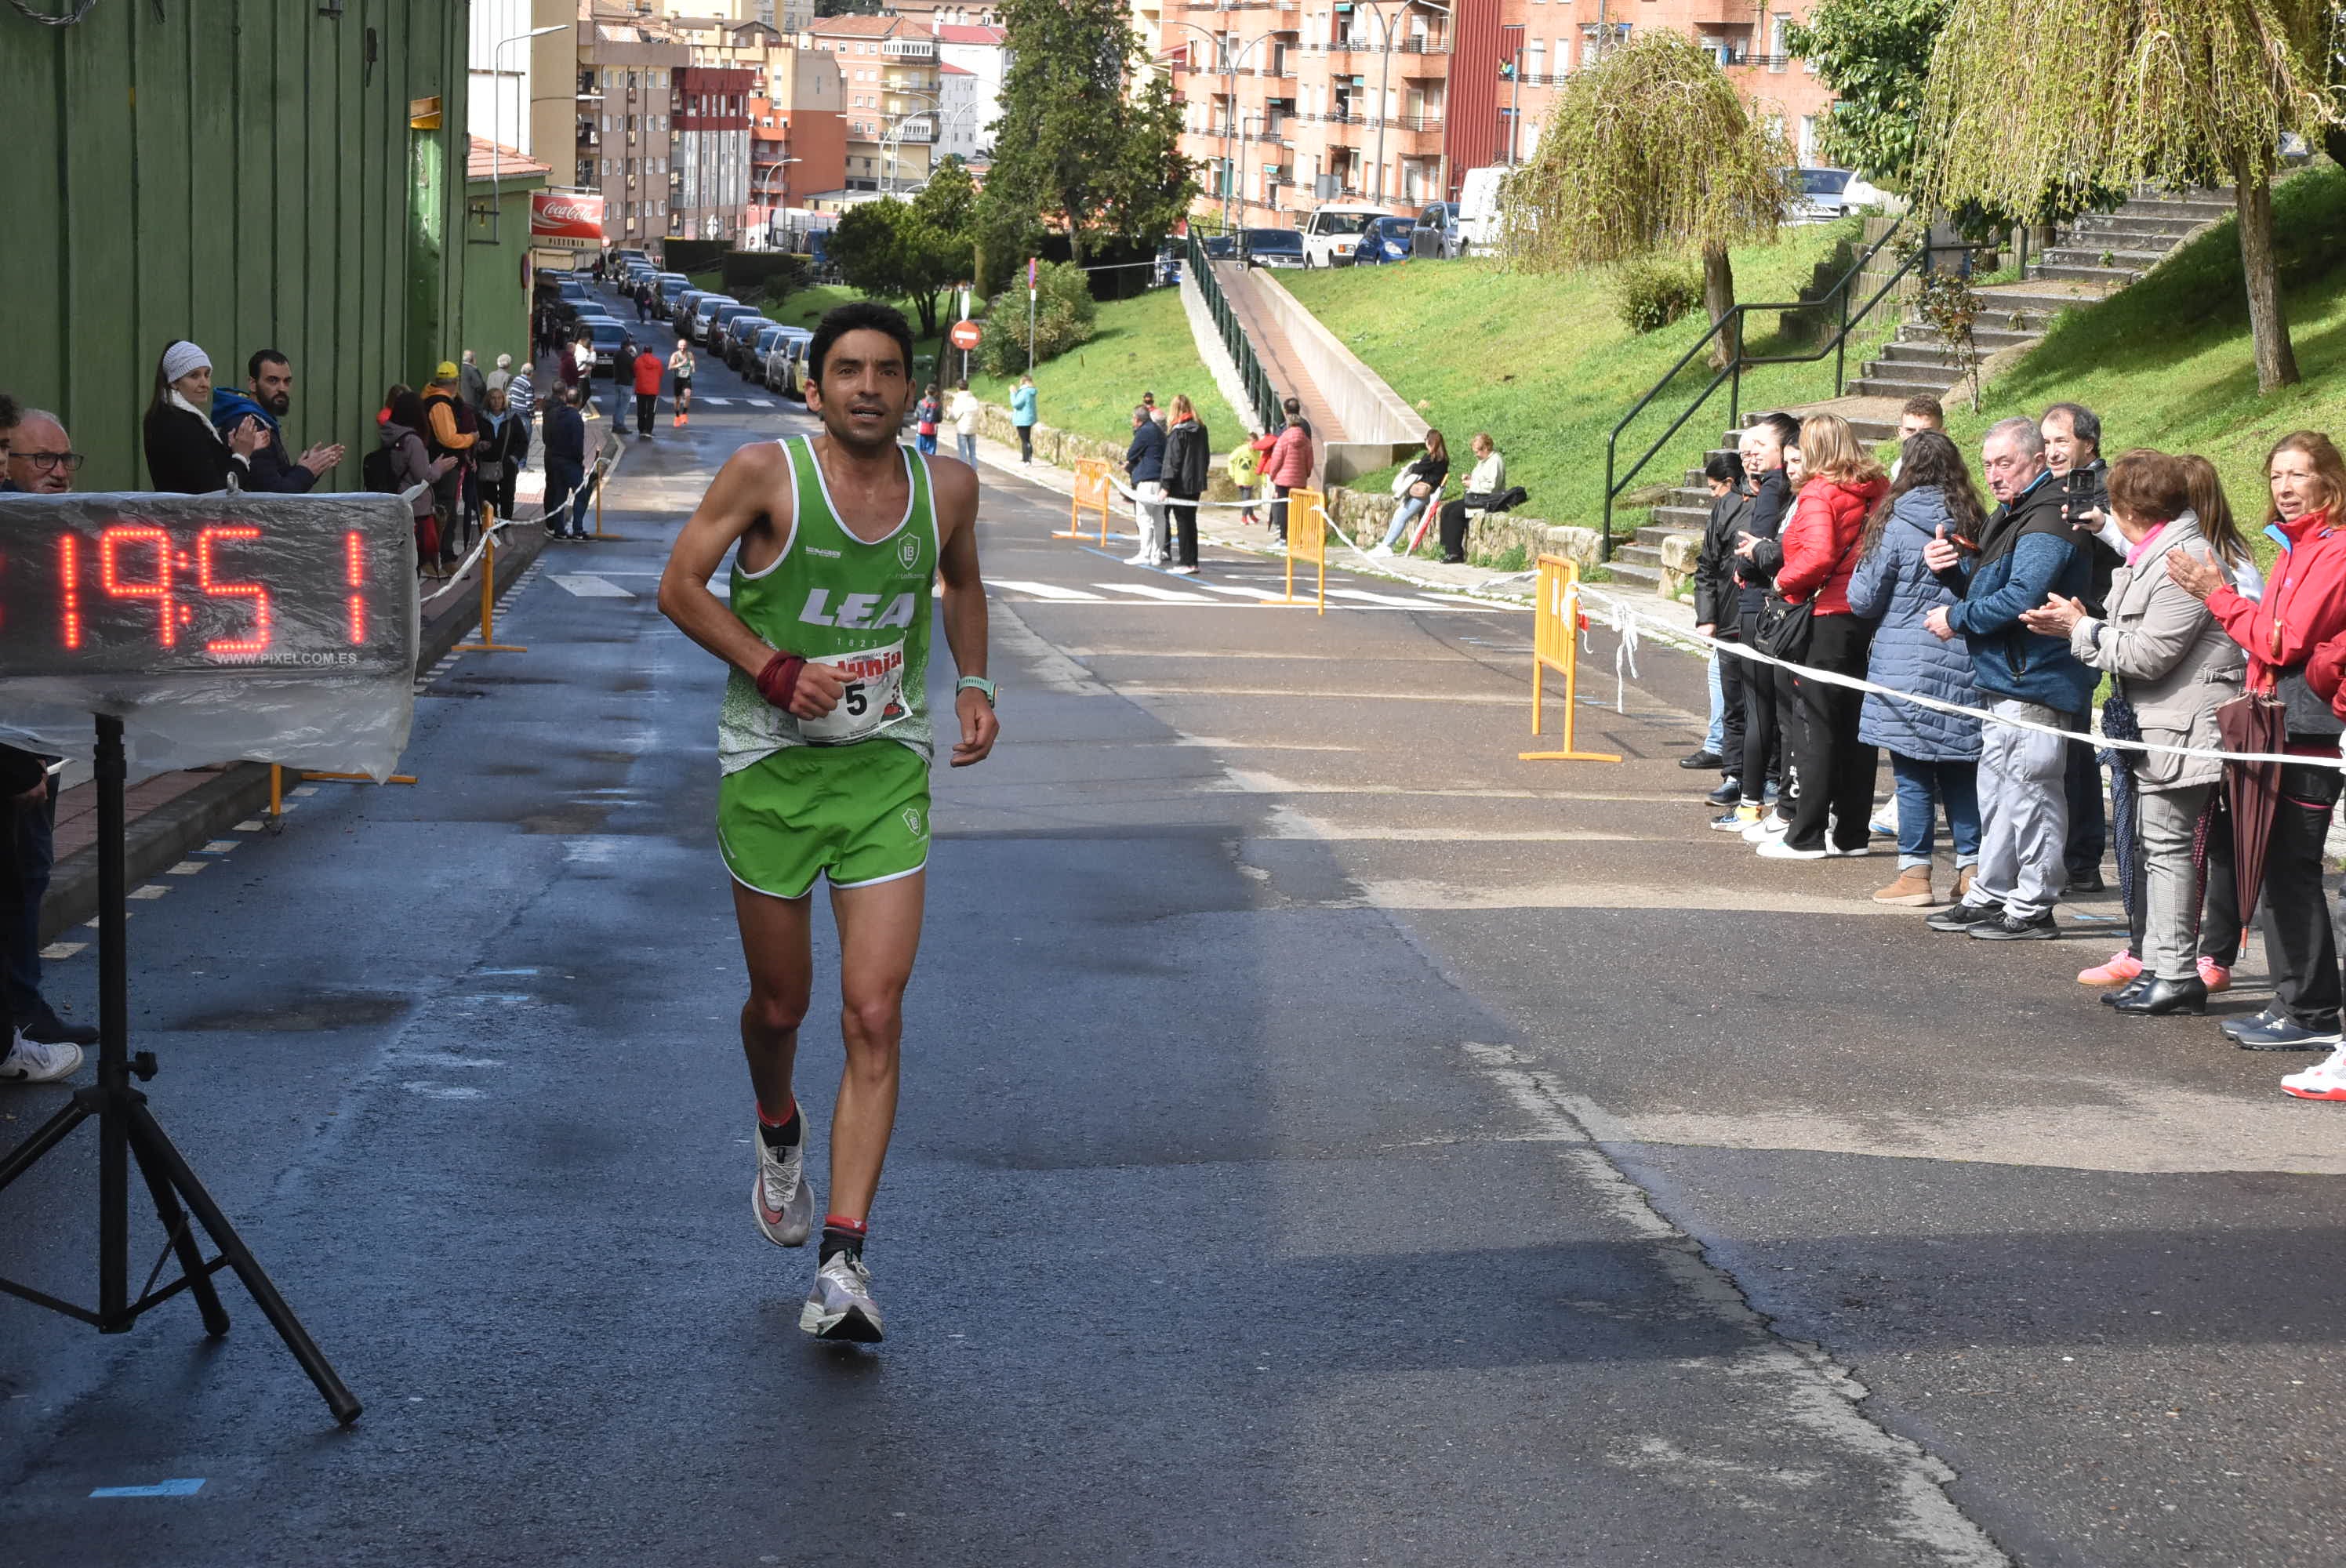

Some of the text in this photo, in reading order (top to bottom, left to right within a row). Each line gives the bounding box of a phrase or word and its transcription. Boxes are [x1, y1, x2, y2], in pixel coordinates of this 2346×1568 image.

[548, 238, 585, 247] PIZZERIA
[798, 588, 915, 630] LEA
[216, 652, 358, 665] WWW.PIXELCOM.ES
[845, 683, 868, 717] 5
